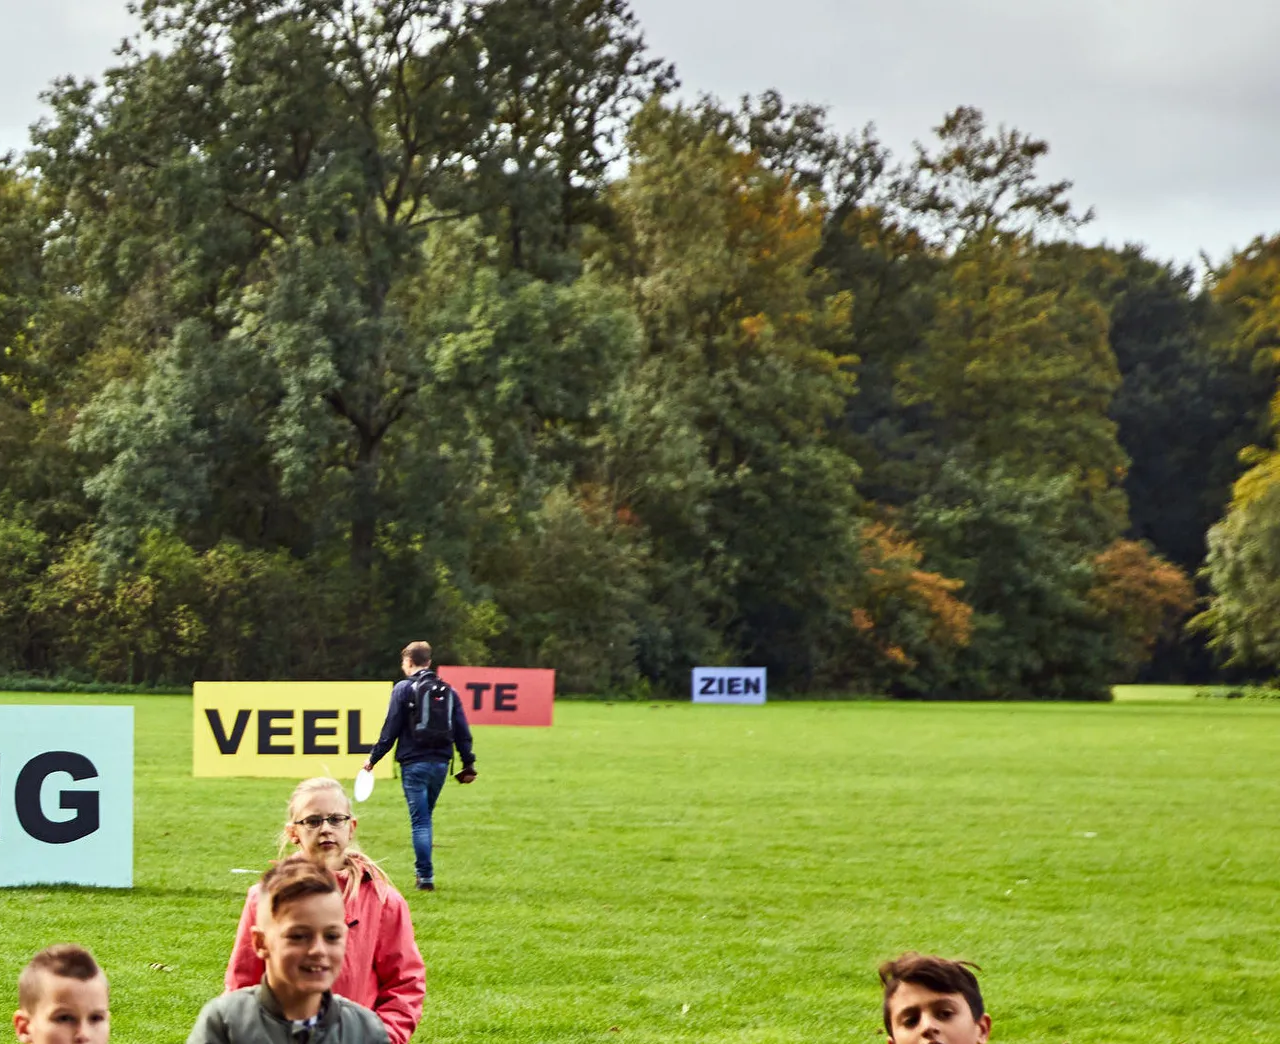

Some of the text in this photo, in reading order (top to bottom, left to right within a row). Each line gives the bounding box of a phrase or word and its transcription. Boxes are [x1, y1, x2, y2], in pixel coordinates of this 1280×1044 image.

[465, 683, 518, 711] TE
[699, 677, 761, 695] ZIEN
[205, 709, 377, 755] VEEL
